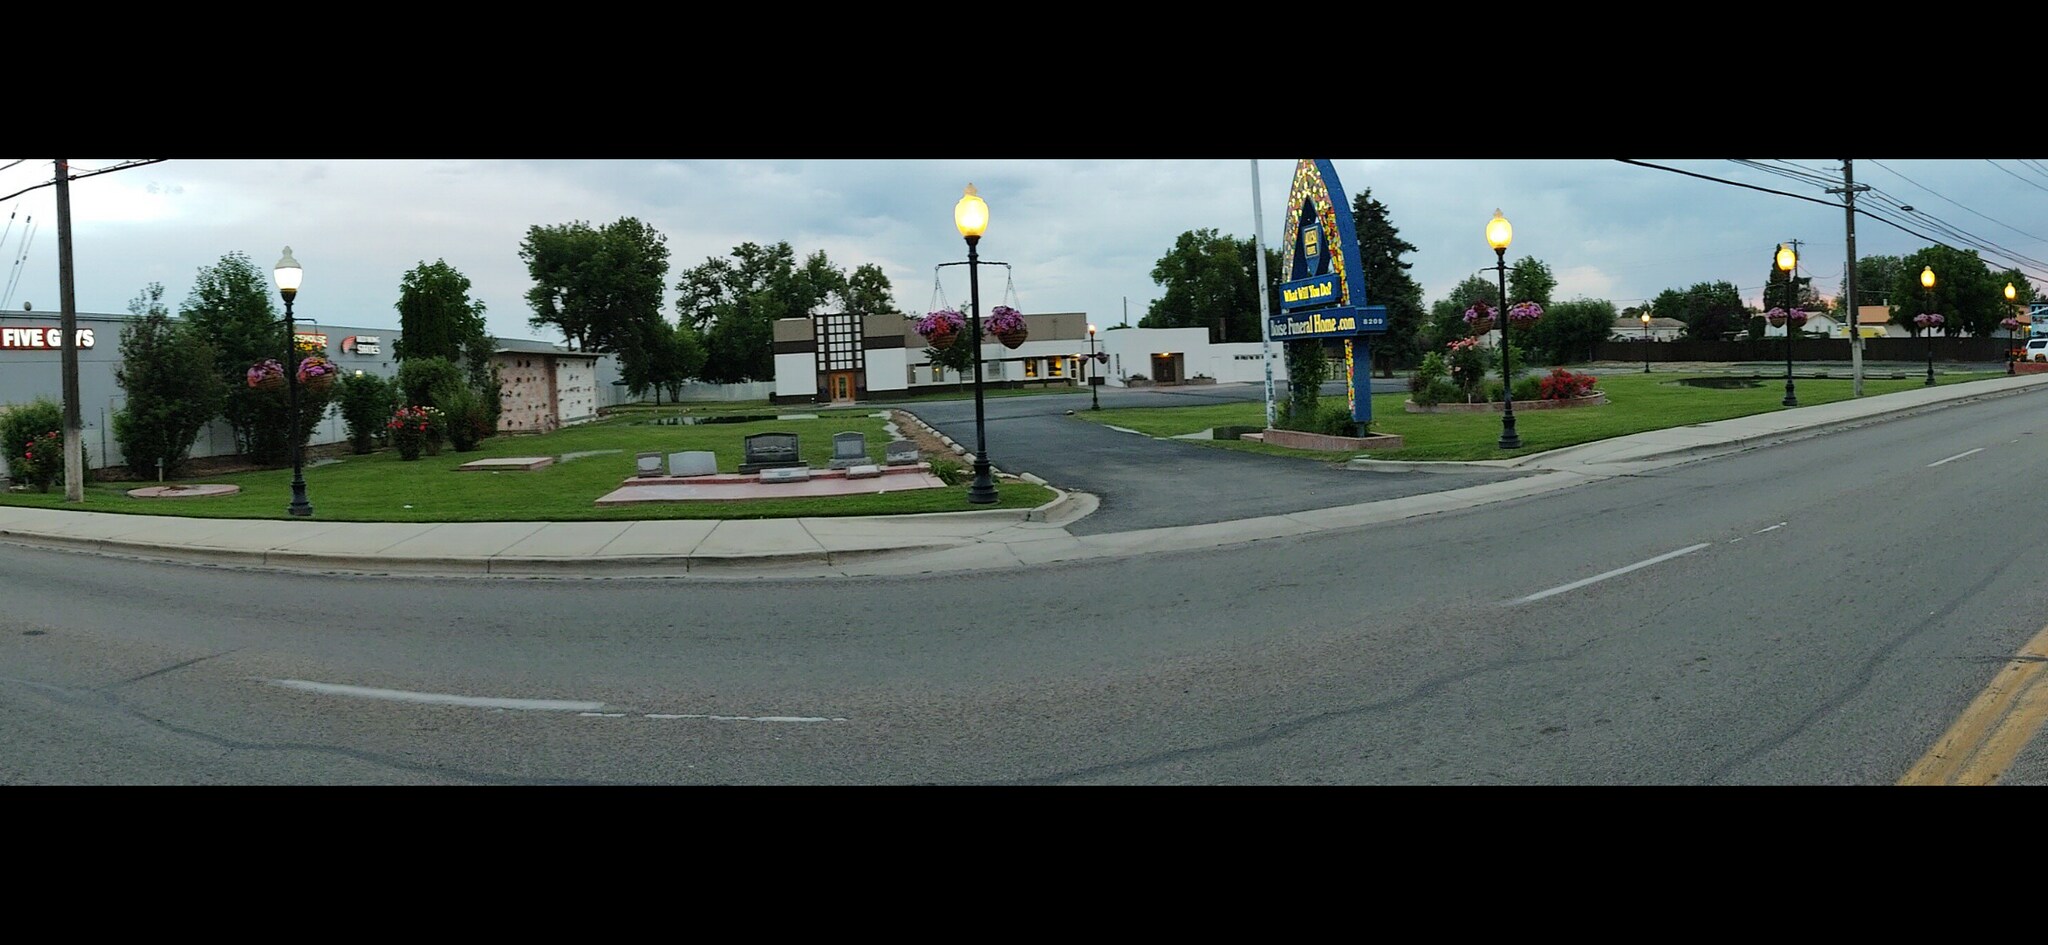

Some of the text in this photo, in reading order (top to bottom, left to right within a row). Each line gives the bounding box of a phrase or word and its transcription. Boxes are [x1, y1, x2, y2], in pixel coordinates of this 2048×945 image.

[1283, 281, 1332, 302] What Will You Do?
[1270, 320, 1287, 337] Boise
[1287, 315, 1313, 336] Funeral
[1313, 314, 1336, 333] Home
[2, 328, 95, 347] FIVE GYS
